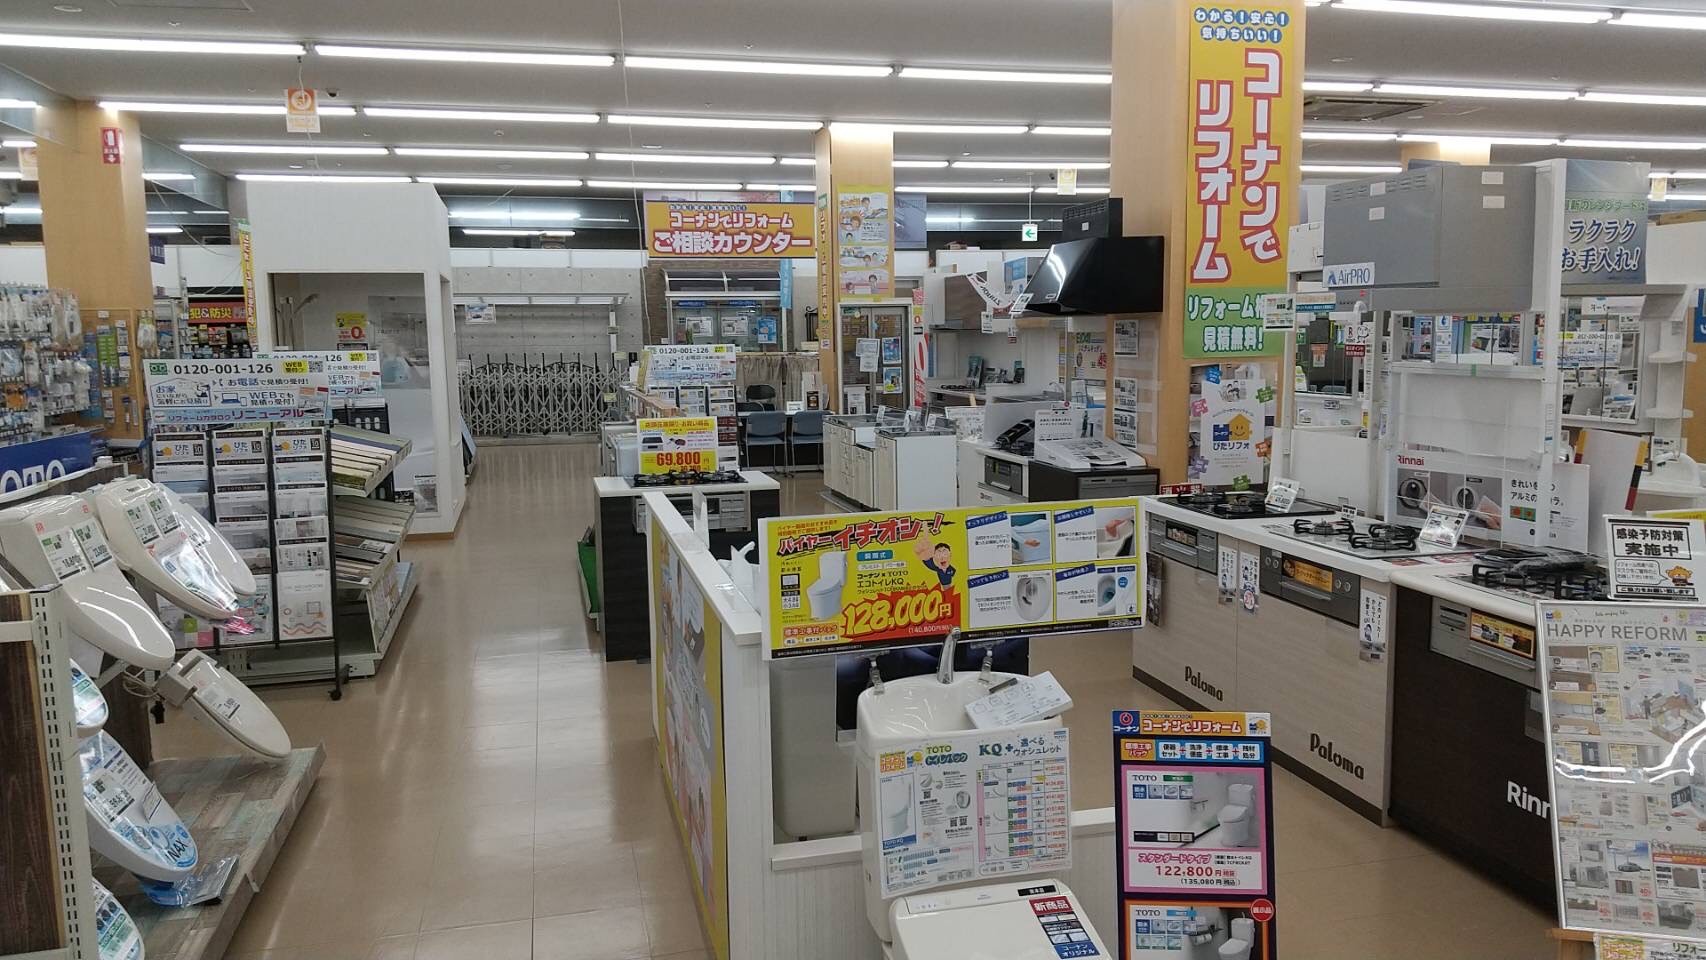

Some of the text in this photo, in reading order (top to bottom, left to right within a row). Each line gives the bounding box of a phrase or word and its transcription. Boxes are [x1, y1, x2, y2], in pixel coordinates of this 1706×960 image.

[1195, 8, 1289, 27] わかる!安心!
[1201, 25, 1282, 43] 気持ちいい!
[1241, 49, 1282, 262] コーナンで
[1193, 81, 1234, 281] リフォーム
[670, 212, 793, 229] コーナンでリフォーム
[1568, 219, 1638, 243] ラクラク
[653, 230, 811, 254] ご相談カウンター
[1338, 269, 1371, 285] AirPRO
[173, 363, 273, 374] 0120-001-126
[1616, 528, 1684, 541] 感染予防対策
[1625, 542, 1679, 556] 実施中
[857, 578, 905, 588] エコトイレKQ
[1547, 624, 1688, 641] HAPPY REFORM
[1184, 665, 1223, 702] Paloma
[1142, 719, 1242, 733] コーナンでリフォーム
[926, 745, 952, 754] TOTO
[1310, 733, 1364, 781] Paloma
[1138, 853, 1211, 864] スタンダードタイプ
[1155, 865, 1213, 877] 122,800
[1034, 900, 1069, 911] 新商品
